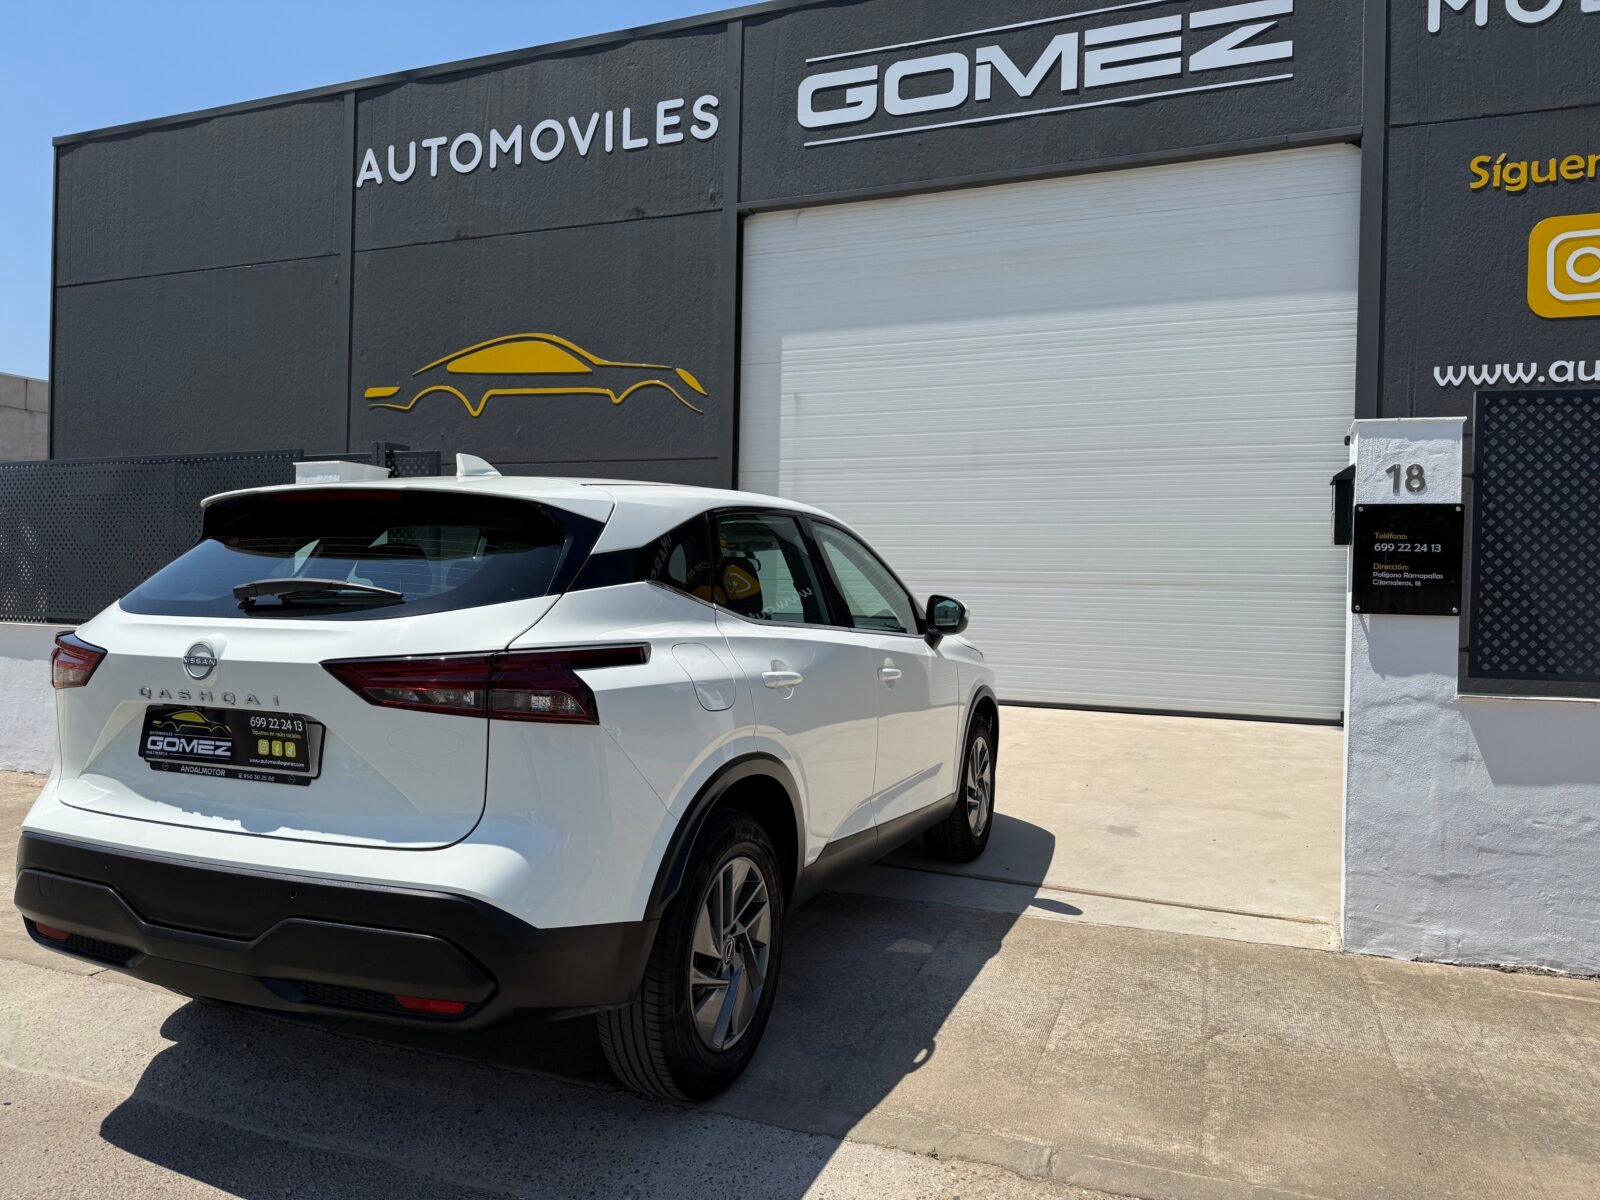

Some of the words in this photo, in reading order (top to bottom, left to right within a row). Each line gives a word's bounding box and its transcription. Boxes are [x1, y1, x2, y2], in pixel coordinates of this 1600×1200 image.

[797, 0, 1294, 128] GOMEZ
[356, 94, 720, 188] AUTOMOVILES
[1385, 463, 1427, 493] 18
[1374, 532, 1408, 540] Teléfono:
[1374, 543, 1395, 552] 699
[1397, 543, 1411, 552] 22
[1413, 543, 1428, 552] 24
[1431, 543, 1442, 553] 13
[183, 657, 217, 666] NISSAN
[139, 686, 281, 706] QASHQAI
[250, 716, 267, 728] 699
[268, 718, 280, 729] 22
[280, 719, 292, 730] 24
[293, 720, 303, 732] 13
[147, 736, 232, 756] GOMEZ
[180, 765, 226, 777] ANDALMOTOR
